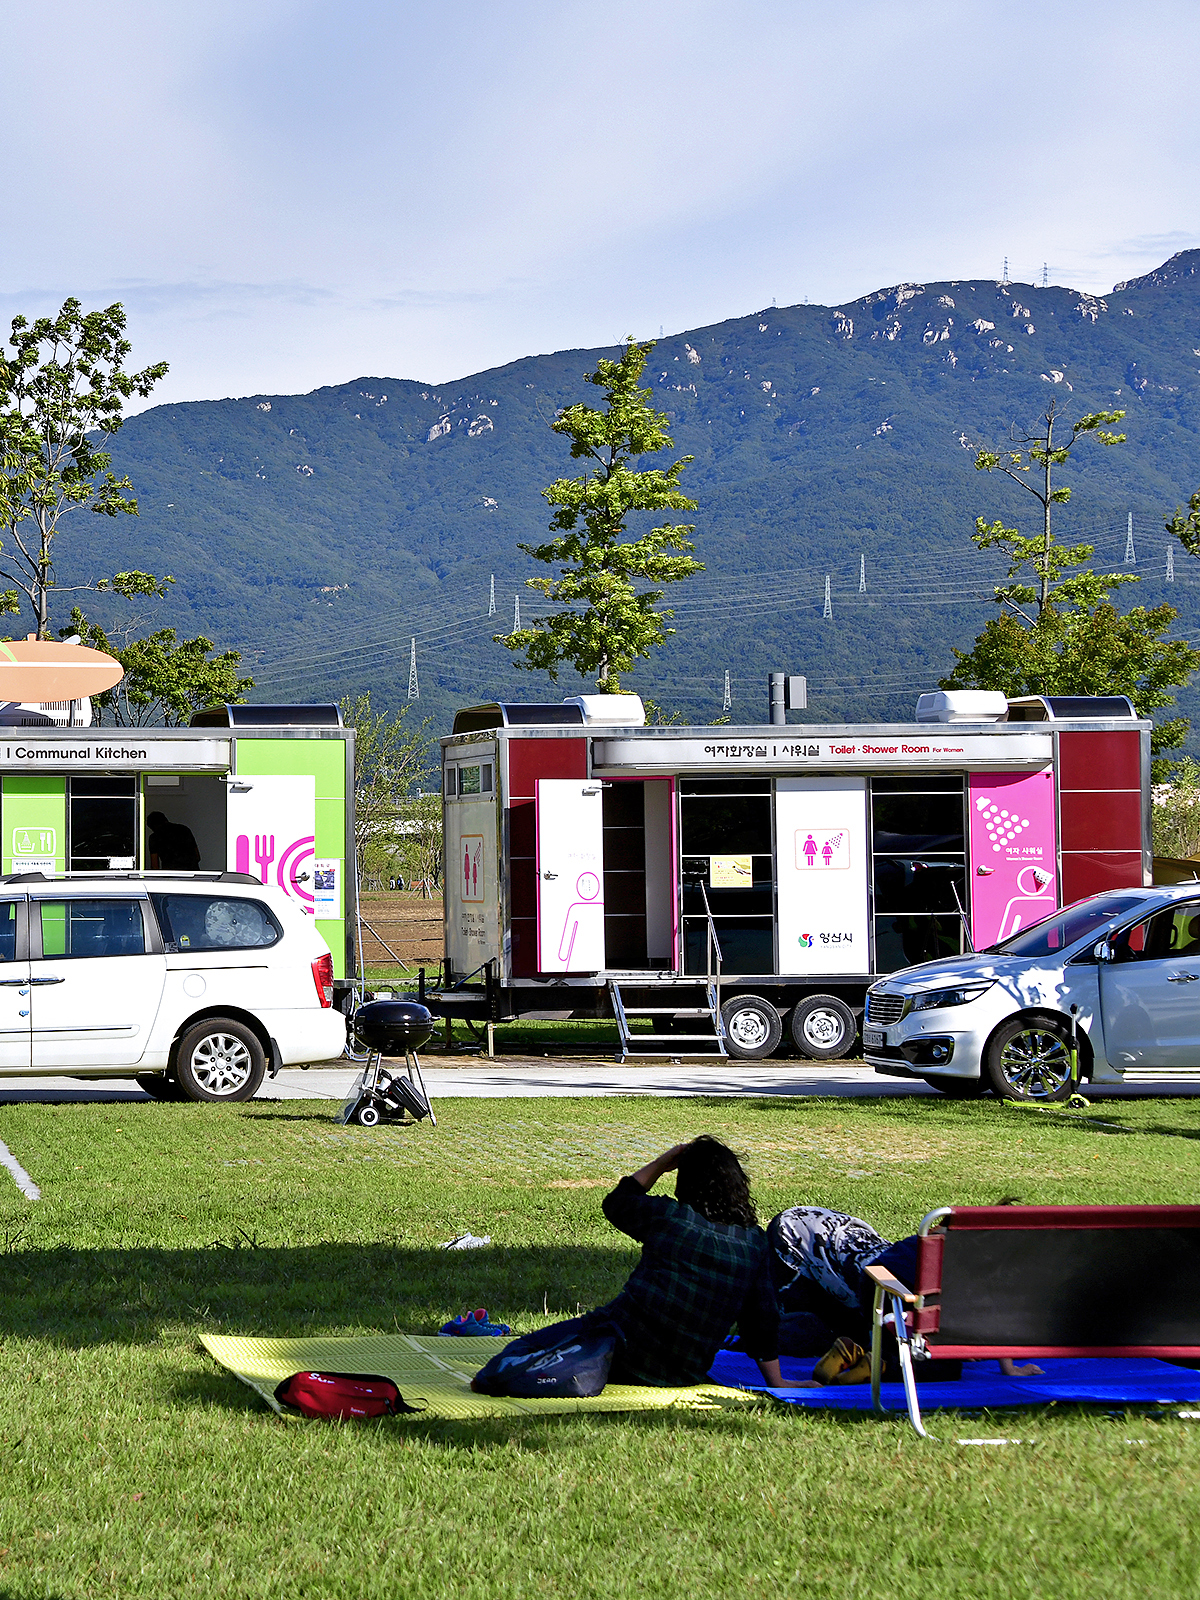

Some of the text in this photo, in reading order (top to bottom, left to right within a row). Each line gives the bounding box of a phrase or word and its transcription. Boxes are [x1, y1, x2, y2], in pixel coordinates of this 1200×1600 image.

[15, 747, 90, 759] Communal
[95, 747, 147, 759] Kitchen
[704, 745, 767, 757] 여자화장실
[782, 745, 820, 757] 샤워실
[829, 745, 856, 754] Toilet
[862, 744, 899, 754] Shower
[901, 744, 930, 753] Room
[1005, 847, 1043, 855] 여자 샤워실
[819, 933, 853, 943] 양산시
